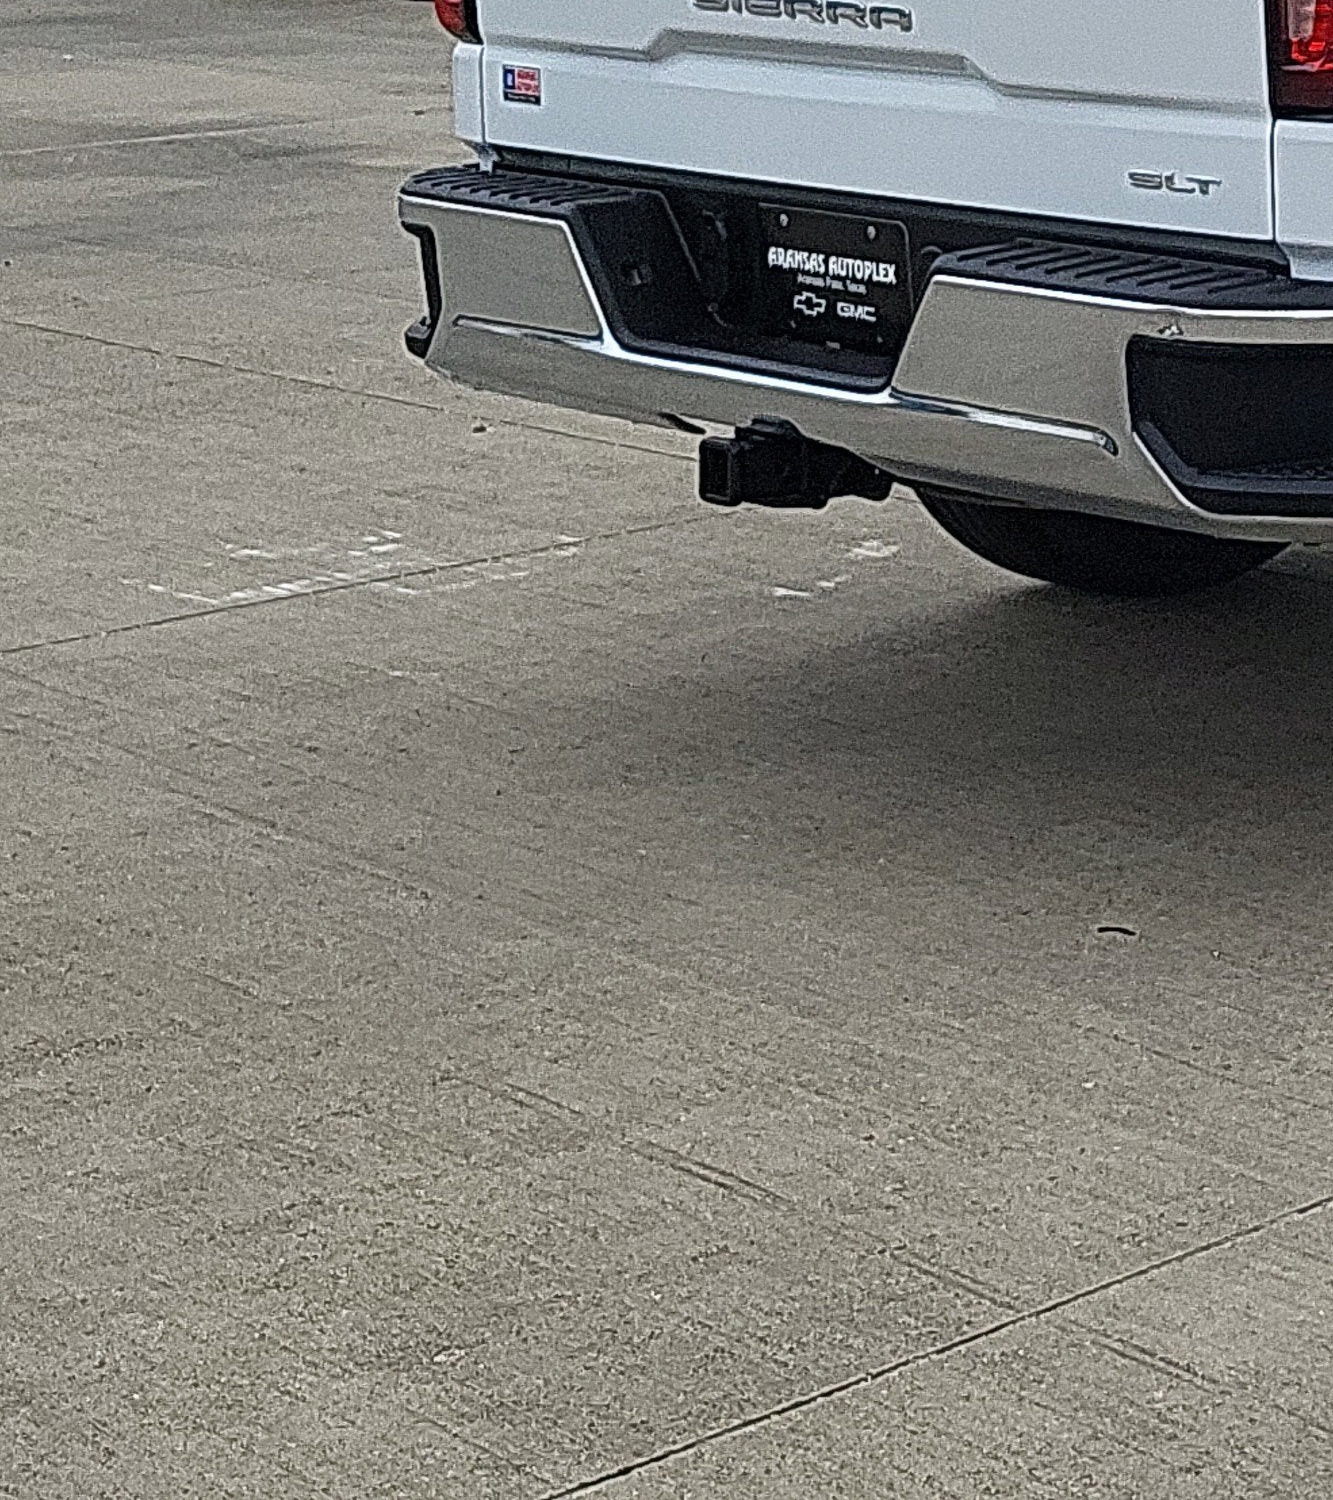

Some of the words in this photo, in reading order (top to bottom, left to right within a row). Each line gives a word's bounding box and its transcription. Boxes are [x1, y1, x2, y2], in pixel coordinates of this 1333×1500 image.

[1128, 172, 1222, 195] SLT
[768, 246, 826, 275] ARANSAS
[828, 255, 897, 285] AUTOPLEX
